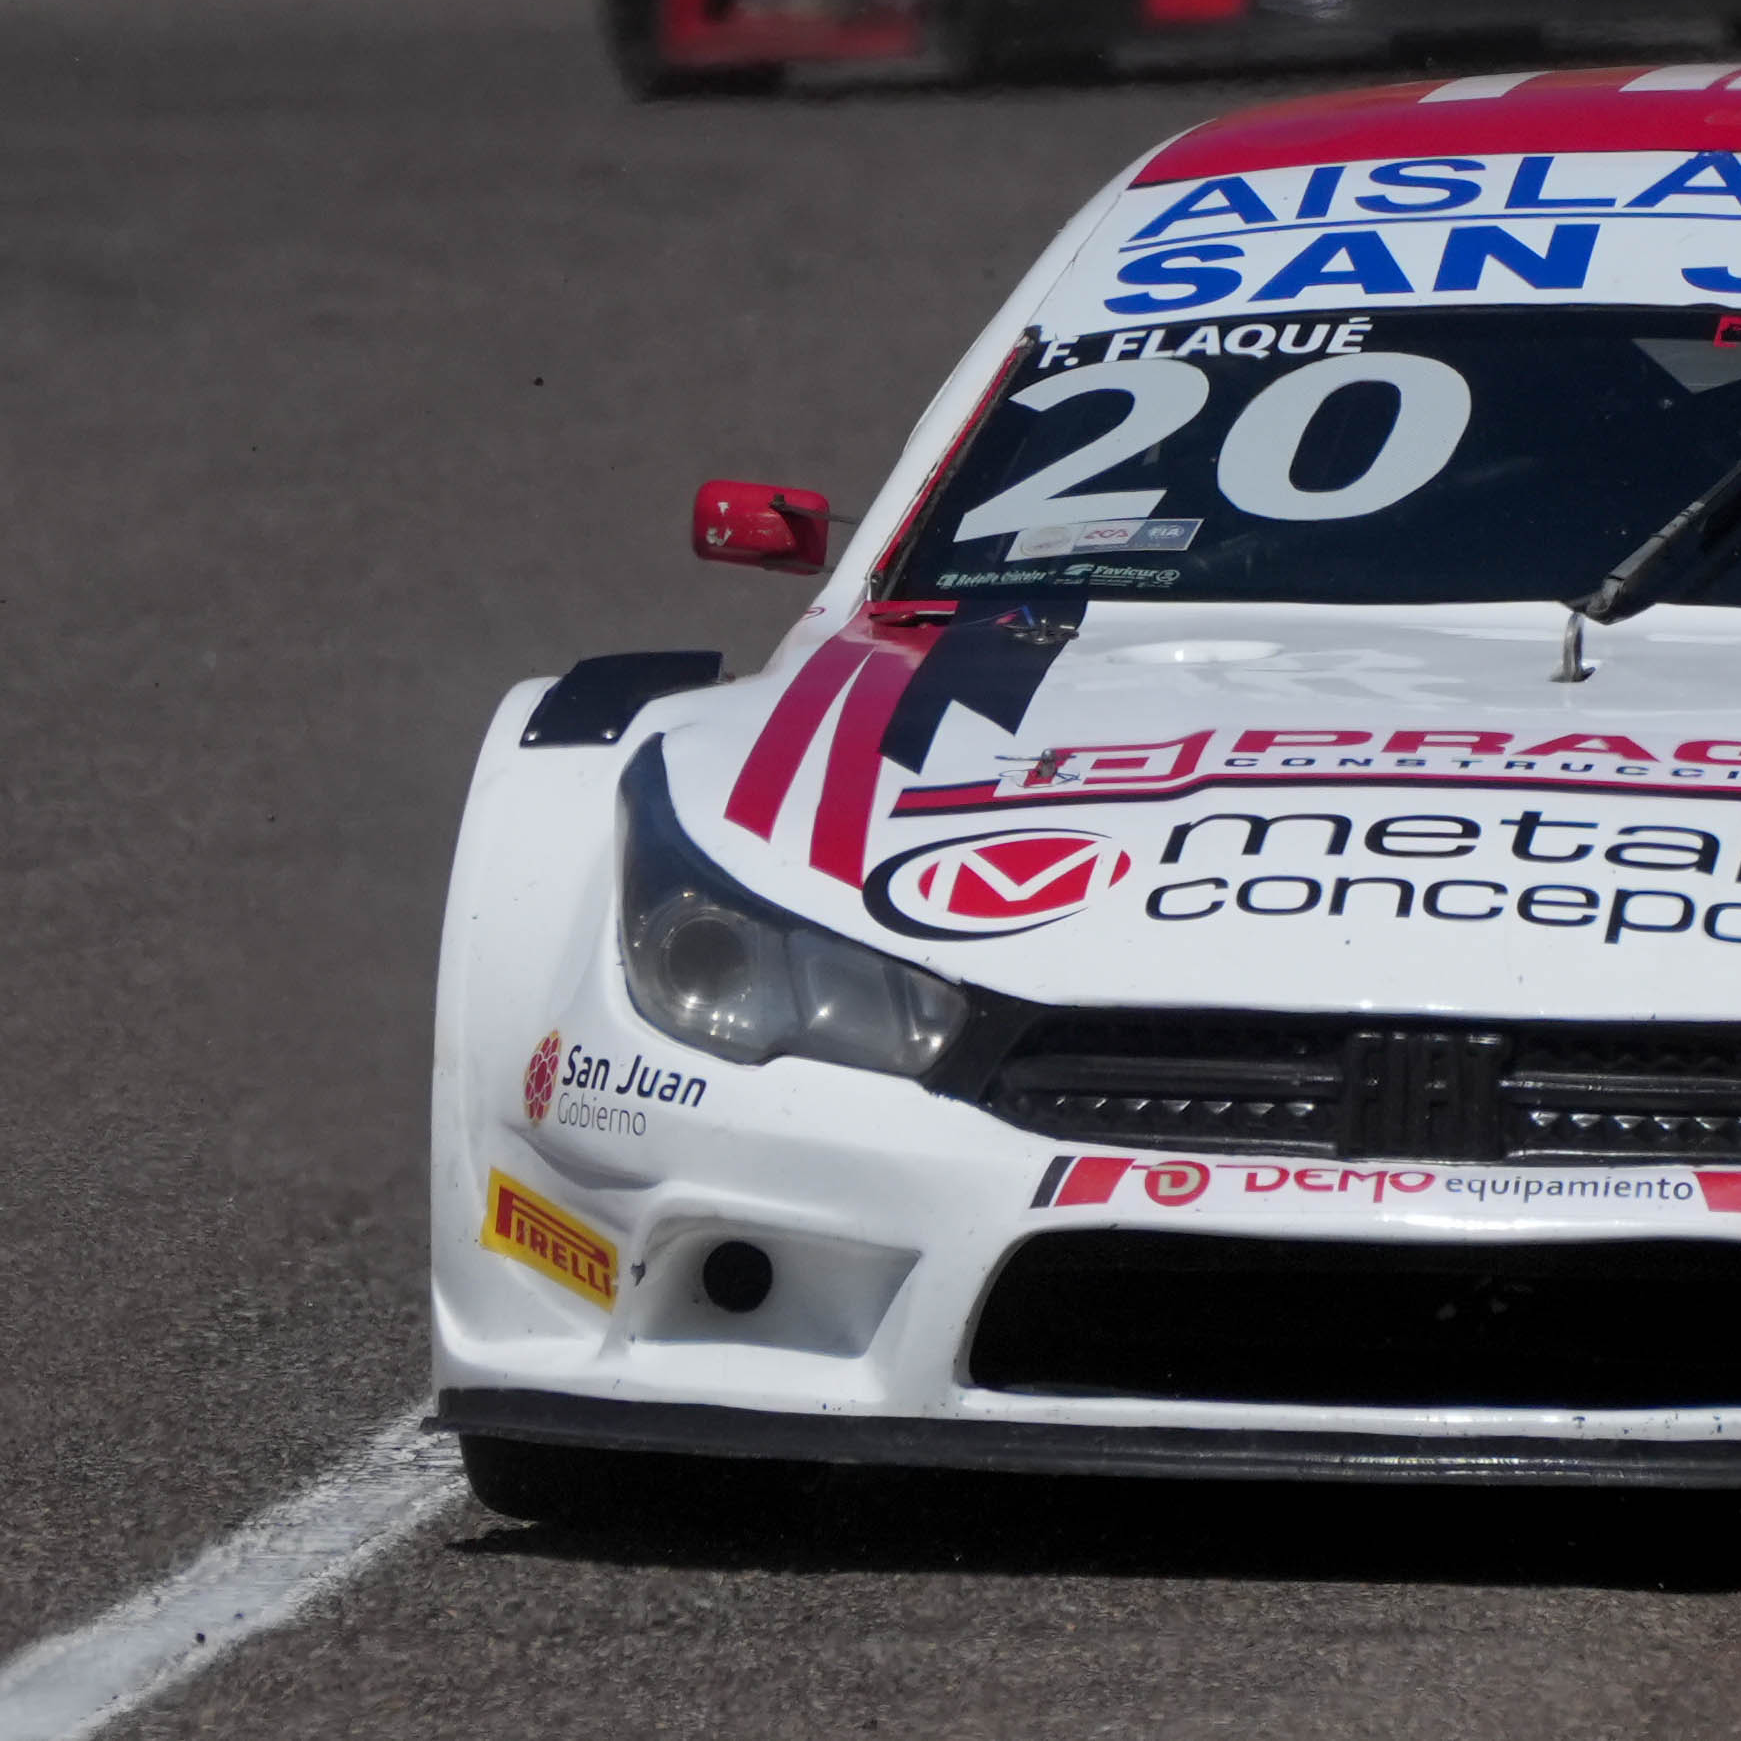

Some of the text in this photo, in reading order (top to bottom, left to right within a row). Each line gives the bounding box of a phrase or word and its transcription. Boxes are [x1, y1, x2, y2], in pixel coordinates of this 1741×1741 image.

[1103, 223, 1601, 315] SAN
[1039, 316, 1374, 370] F. FLAQUÉ
[953, 351, 1472, 543] 20
[561, 1045, 708, 1109] San Juan
[557, 1093, 647, 1137] Gobierno
[1214, 1164, 1435, 1204] DEMO
[1444, 1171, 1695, 1206] equipamiento
[496, 1185, 613, 1300] PIRELLI
